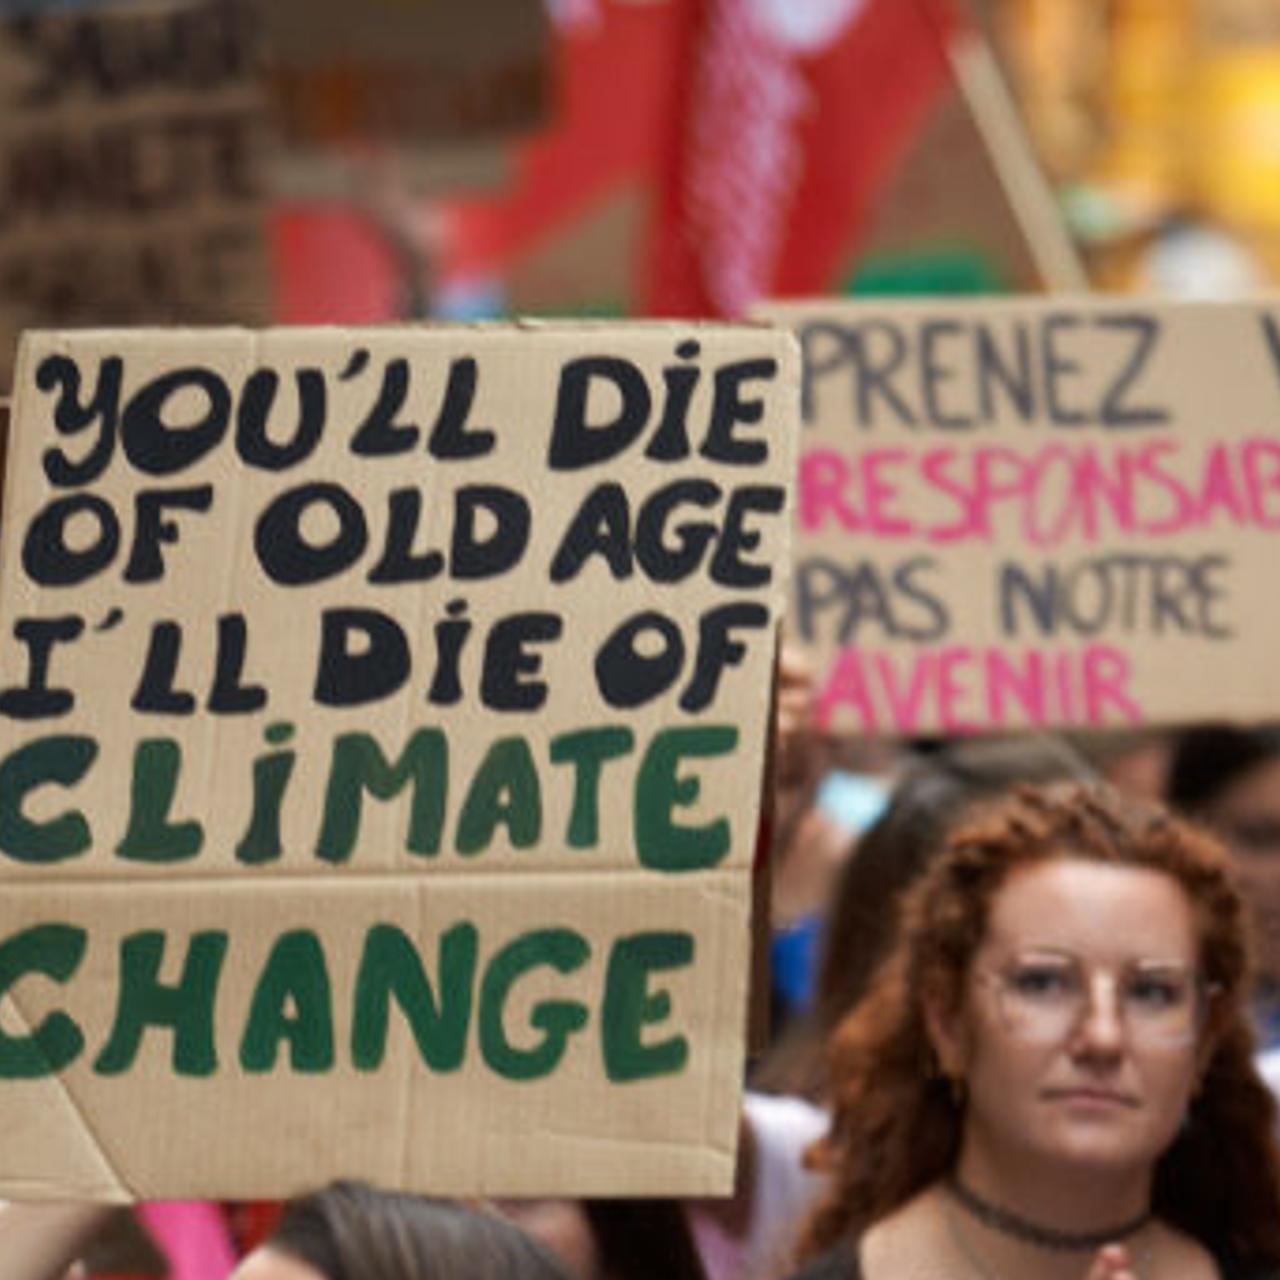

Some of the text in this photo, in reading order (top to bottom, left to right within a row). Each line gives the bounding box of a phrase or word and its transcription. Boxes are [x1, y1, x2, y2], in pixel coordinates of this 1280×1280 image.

[35, 349, 497, 488] YOU'LL
[798, 313, 1168, 425] PRENEZ
[20, 477, 787, 590] OF OLD AGE
[793, 549, 1238, 648] PAS NOTRE
[594, 601, 771, 716] OF
[818, 647, 1140, 732] AVENIR
